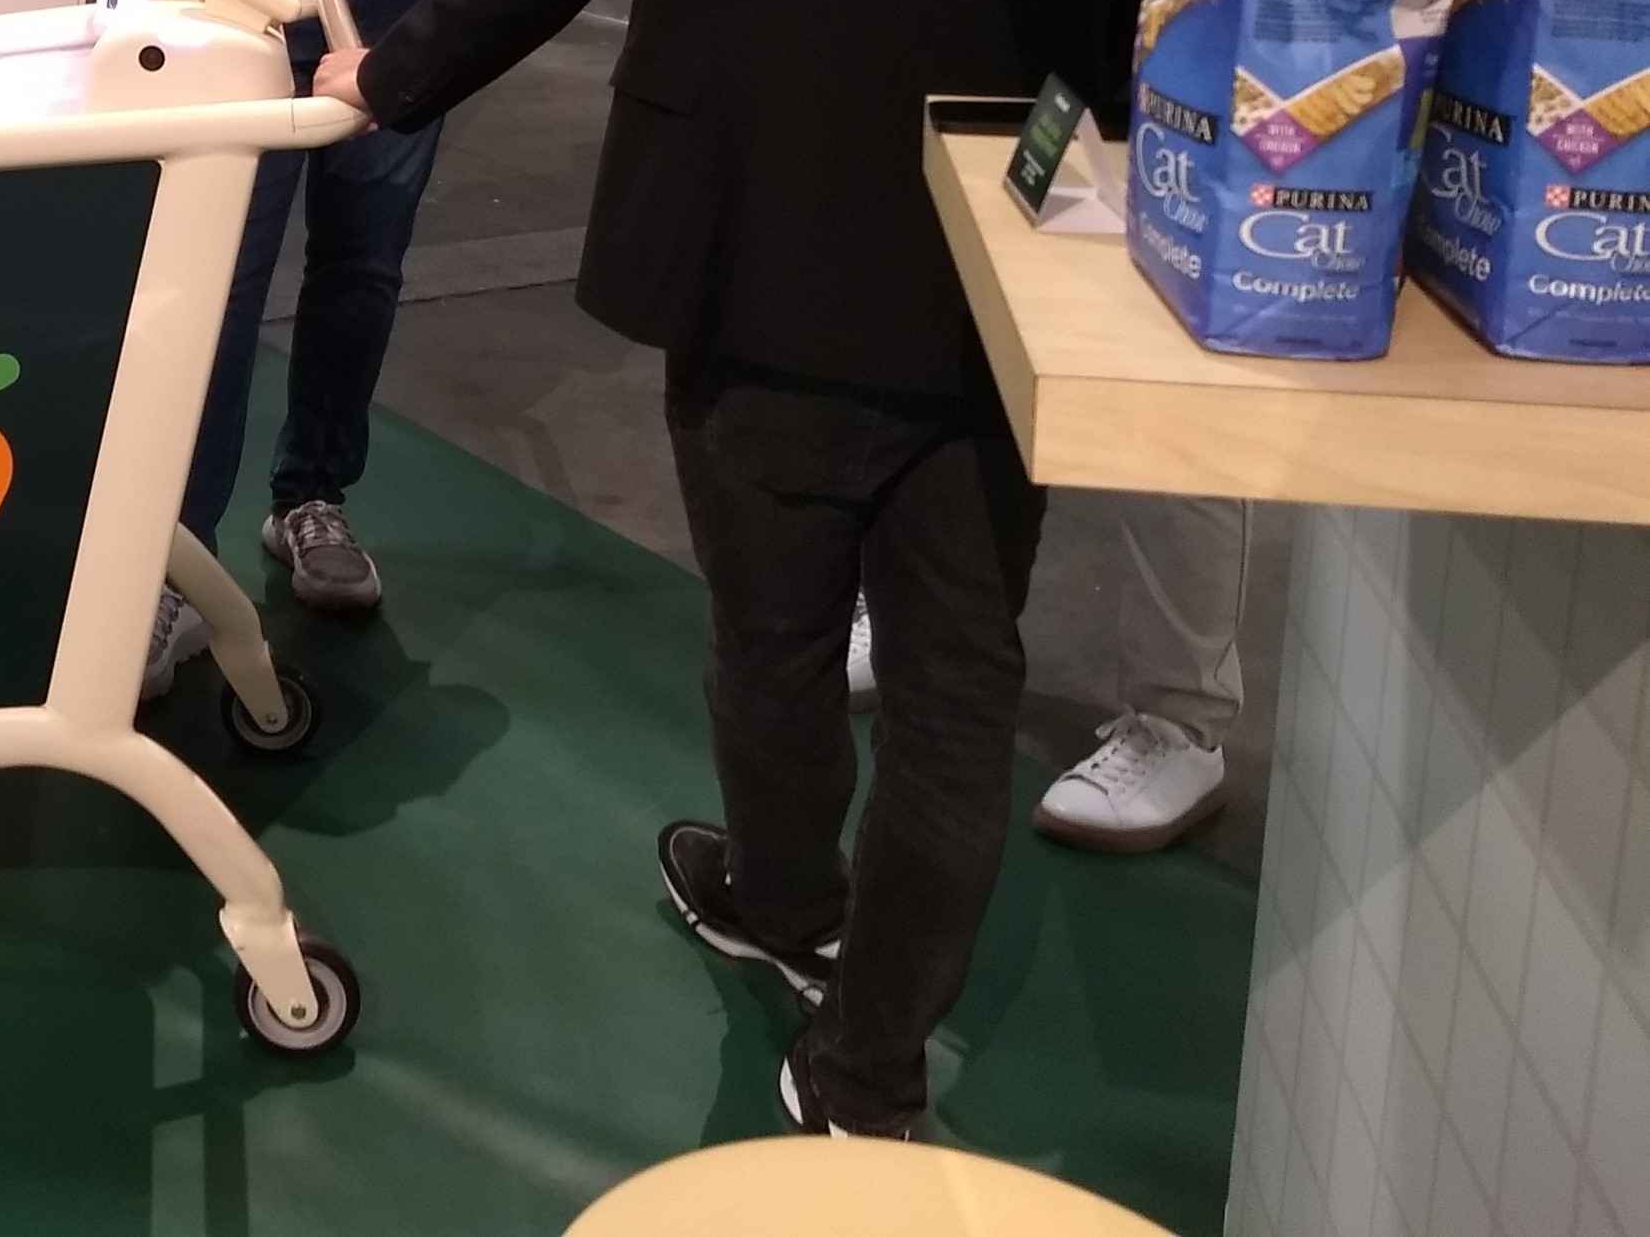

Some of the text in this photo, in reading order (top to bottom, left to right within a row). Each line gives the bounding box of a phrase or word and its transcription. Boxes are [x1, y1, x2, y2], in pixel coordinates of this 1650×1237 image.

[1136, 122, 1200, 202] Cat
[1276, 189, 1369, 210] PURINA
[1574, 190, 1650, 212] PURIN
[1239, 211, 1354, 259] Cat
[1535, 211, 1650, 260] Cat
[1233, 270, 1359, 303] Complete
